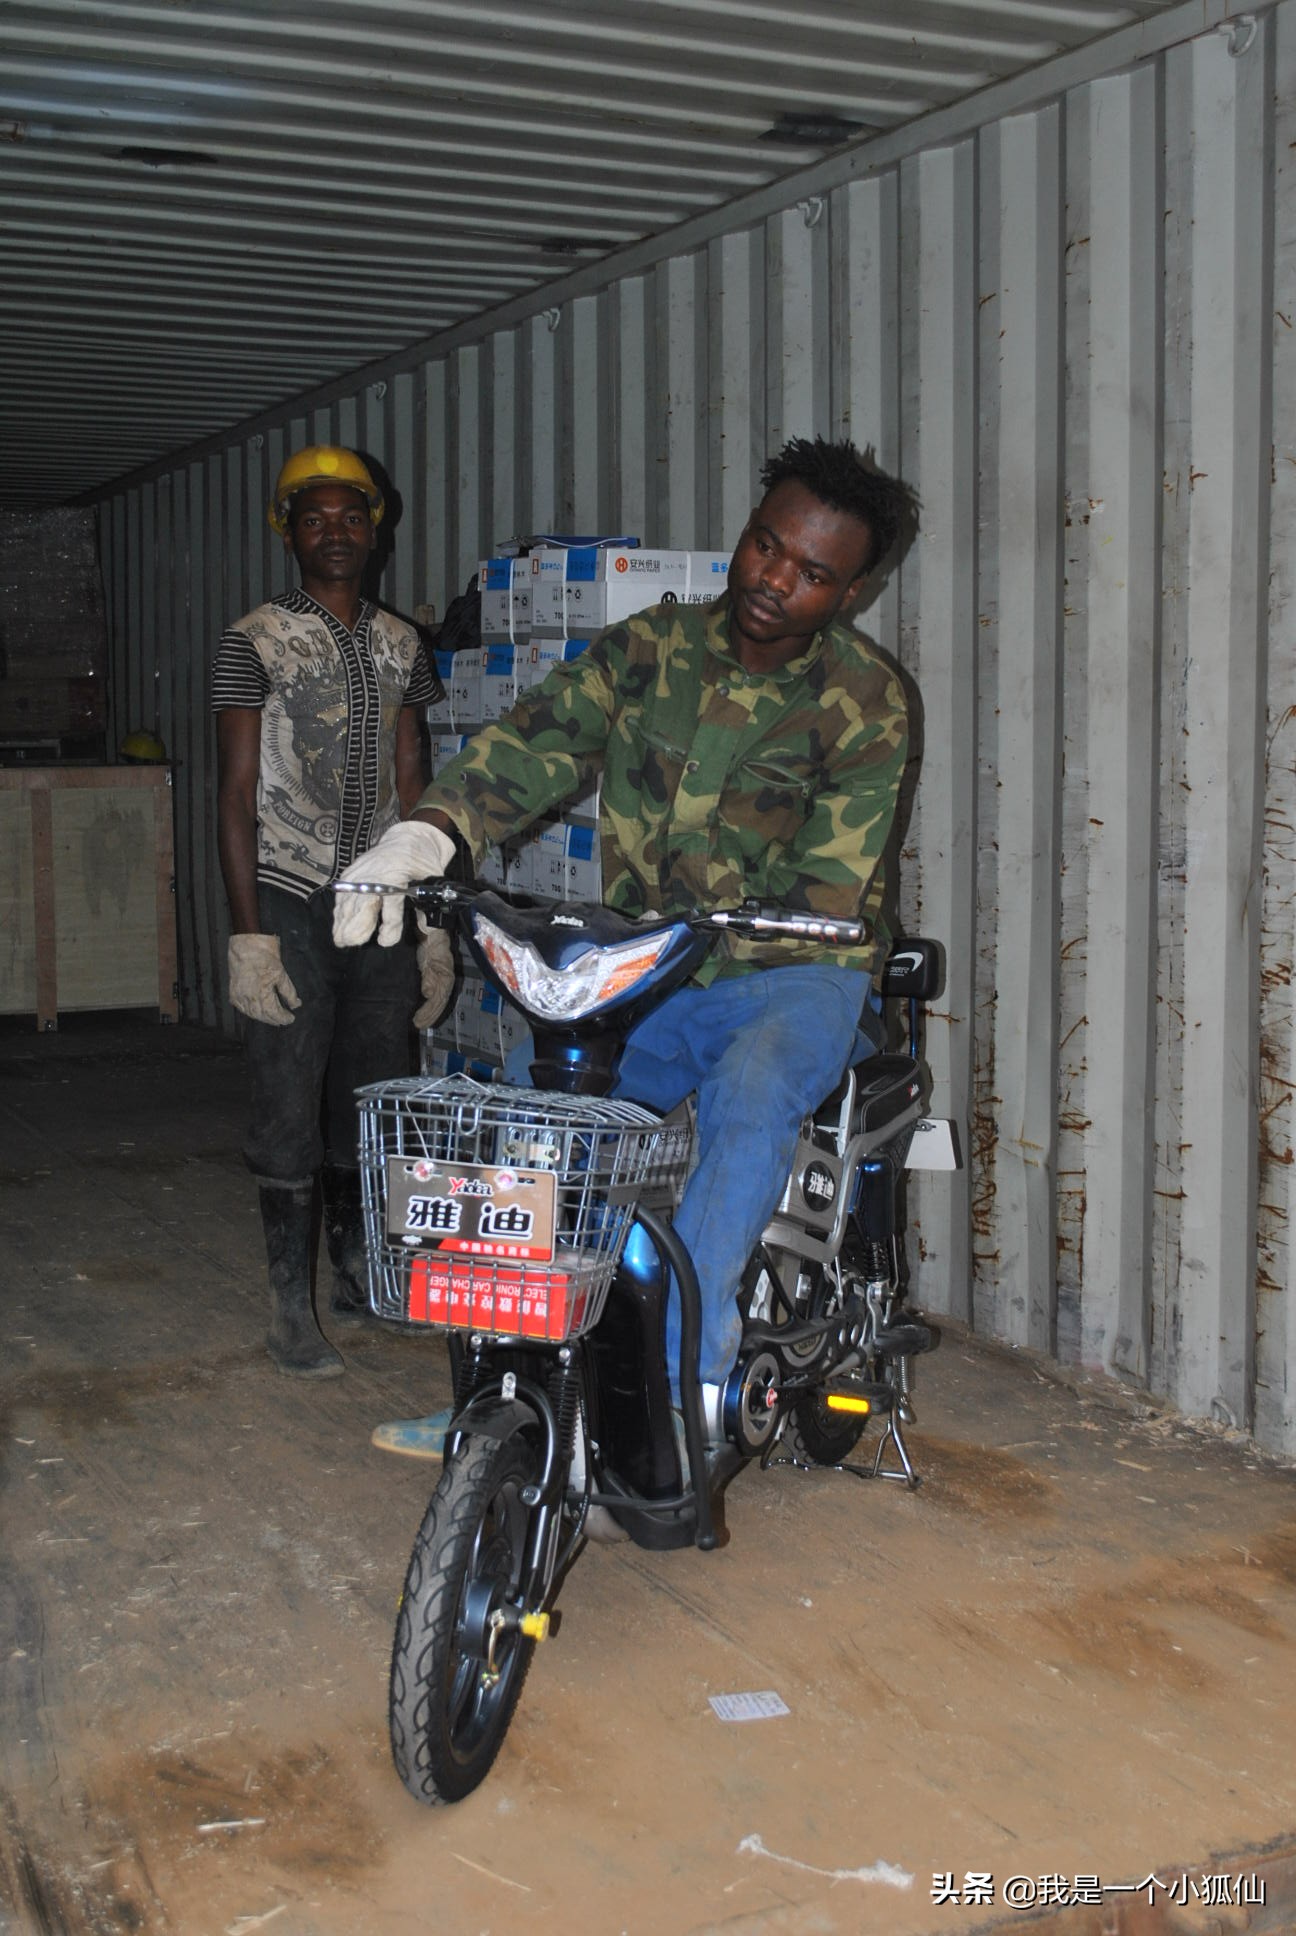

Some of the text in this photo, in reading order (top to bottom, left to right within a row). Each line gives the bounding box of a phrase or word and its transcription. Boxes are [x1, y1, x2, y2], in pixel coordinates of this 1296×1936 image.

[629, 559, 661, 568] 安兴纸业
[448, 1177, 494, 1197] Yadea
[807, 1171, 834, 1201] 雅迪
[405, 1195, 534, 1240] 雅迪
